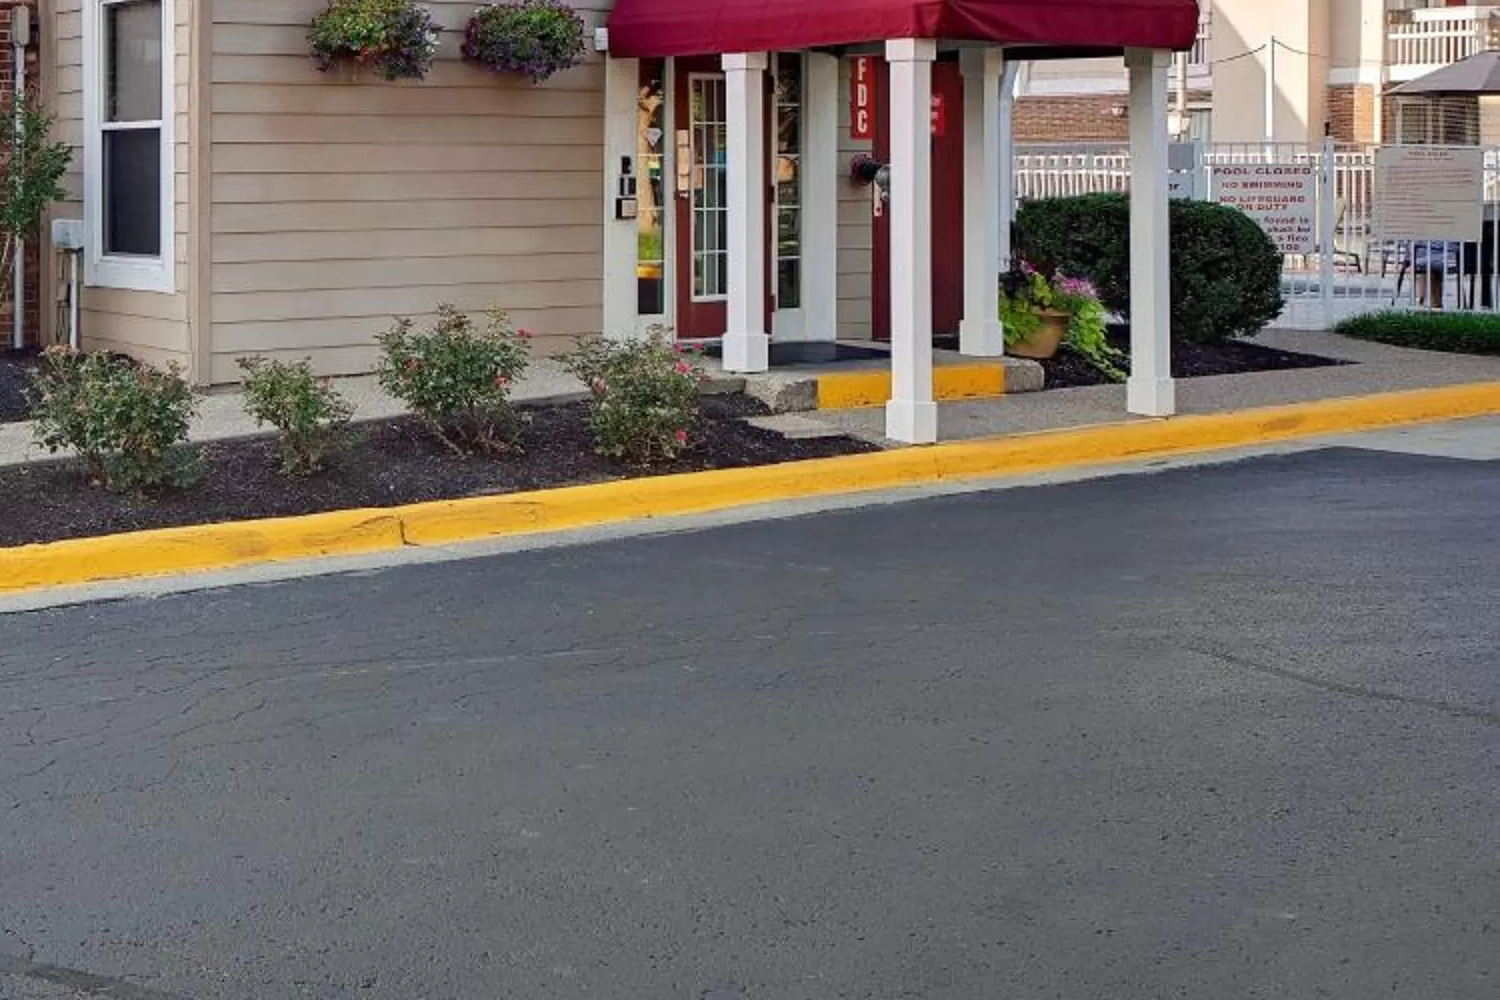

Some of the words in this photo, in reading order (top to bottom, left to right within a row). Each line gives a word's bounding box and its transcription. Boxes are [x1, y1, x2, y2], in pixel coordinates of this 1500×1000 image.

[857, 58, 867, 133] FDC
[1213, 167, 1249, 176] POOL
[1255, 167, 1311, 176] CLOSED
[1221, 181, 1238, 189] NO
[1219, 195, 1237, 203] NO
[1256, 203, 1288, 211] DUTY
